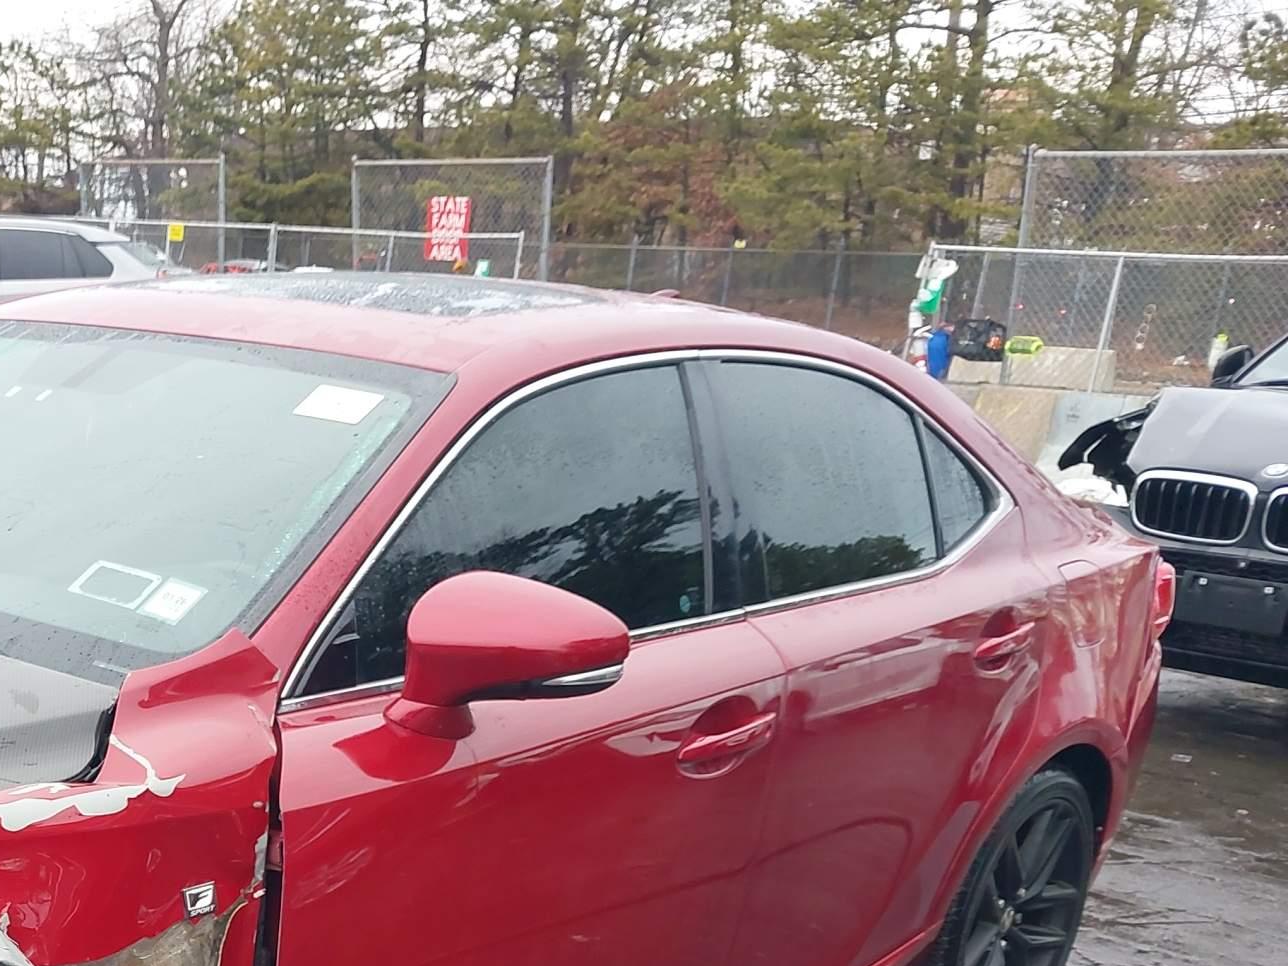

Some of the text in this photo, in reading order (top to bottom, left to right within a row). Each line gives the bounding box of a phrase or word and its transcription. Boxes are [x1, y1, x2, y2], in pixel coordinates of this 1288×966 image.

[431, 195, 469, 213] STATE
[431, 210, 465, 230] FARM
[429, 244, 462, 261] AREA
[189, 904, 216, 918] SPORT
